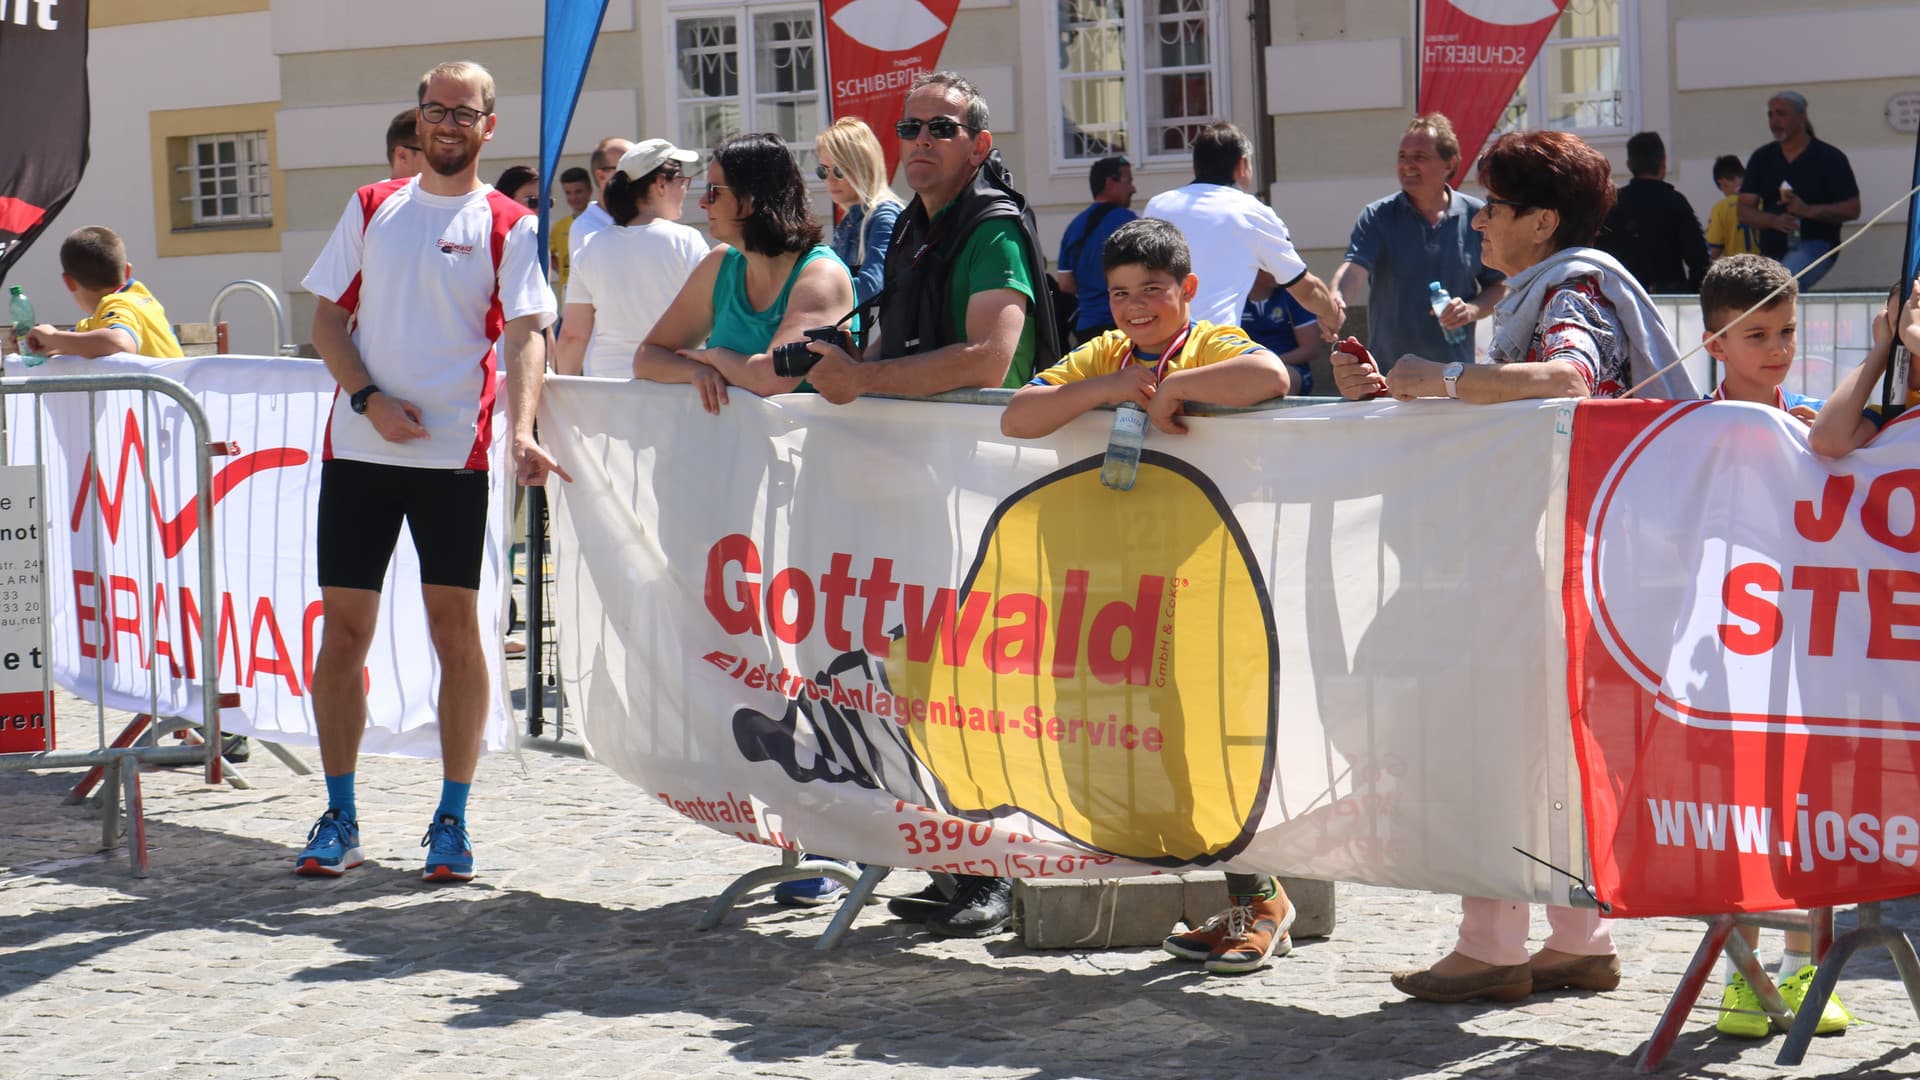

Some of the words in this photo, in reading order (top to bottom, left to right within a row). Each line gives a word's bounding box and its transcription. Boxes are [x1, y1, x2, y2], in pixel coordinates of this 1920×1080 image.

[1794, 468, 1920, 553] JO
[25, 602, 40, 612] 20
[704, 534, 1164, 687] Gottwald
[1162, 624, 1173, 635] &
[1717, 562, 1920, 661] STE
[702, 650, 1164, 752] Elektro-Anlagenbau-Service
[898, 820, 992, 854] 3390
[1647, 793, 1920, 872] www.jose
